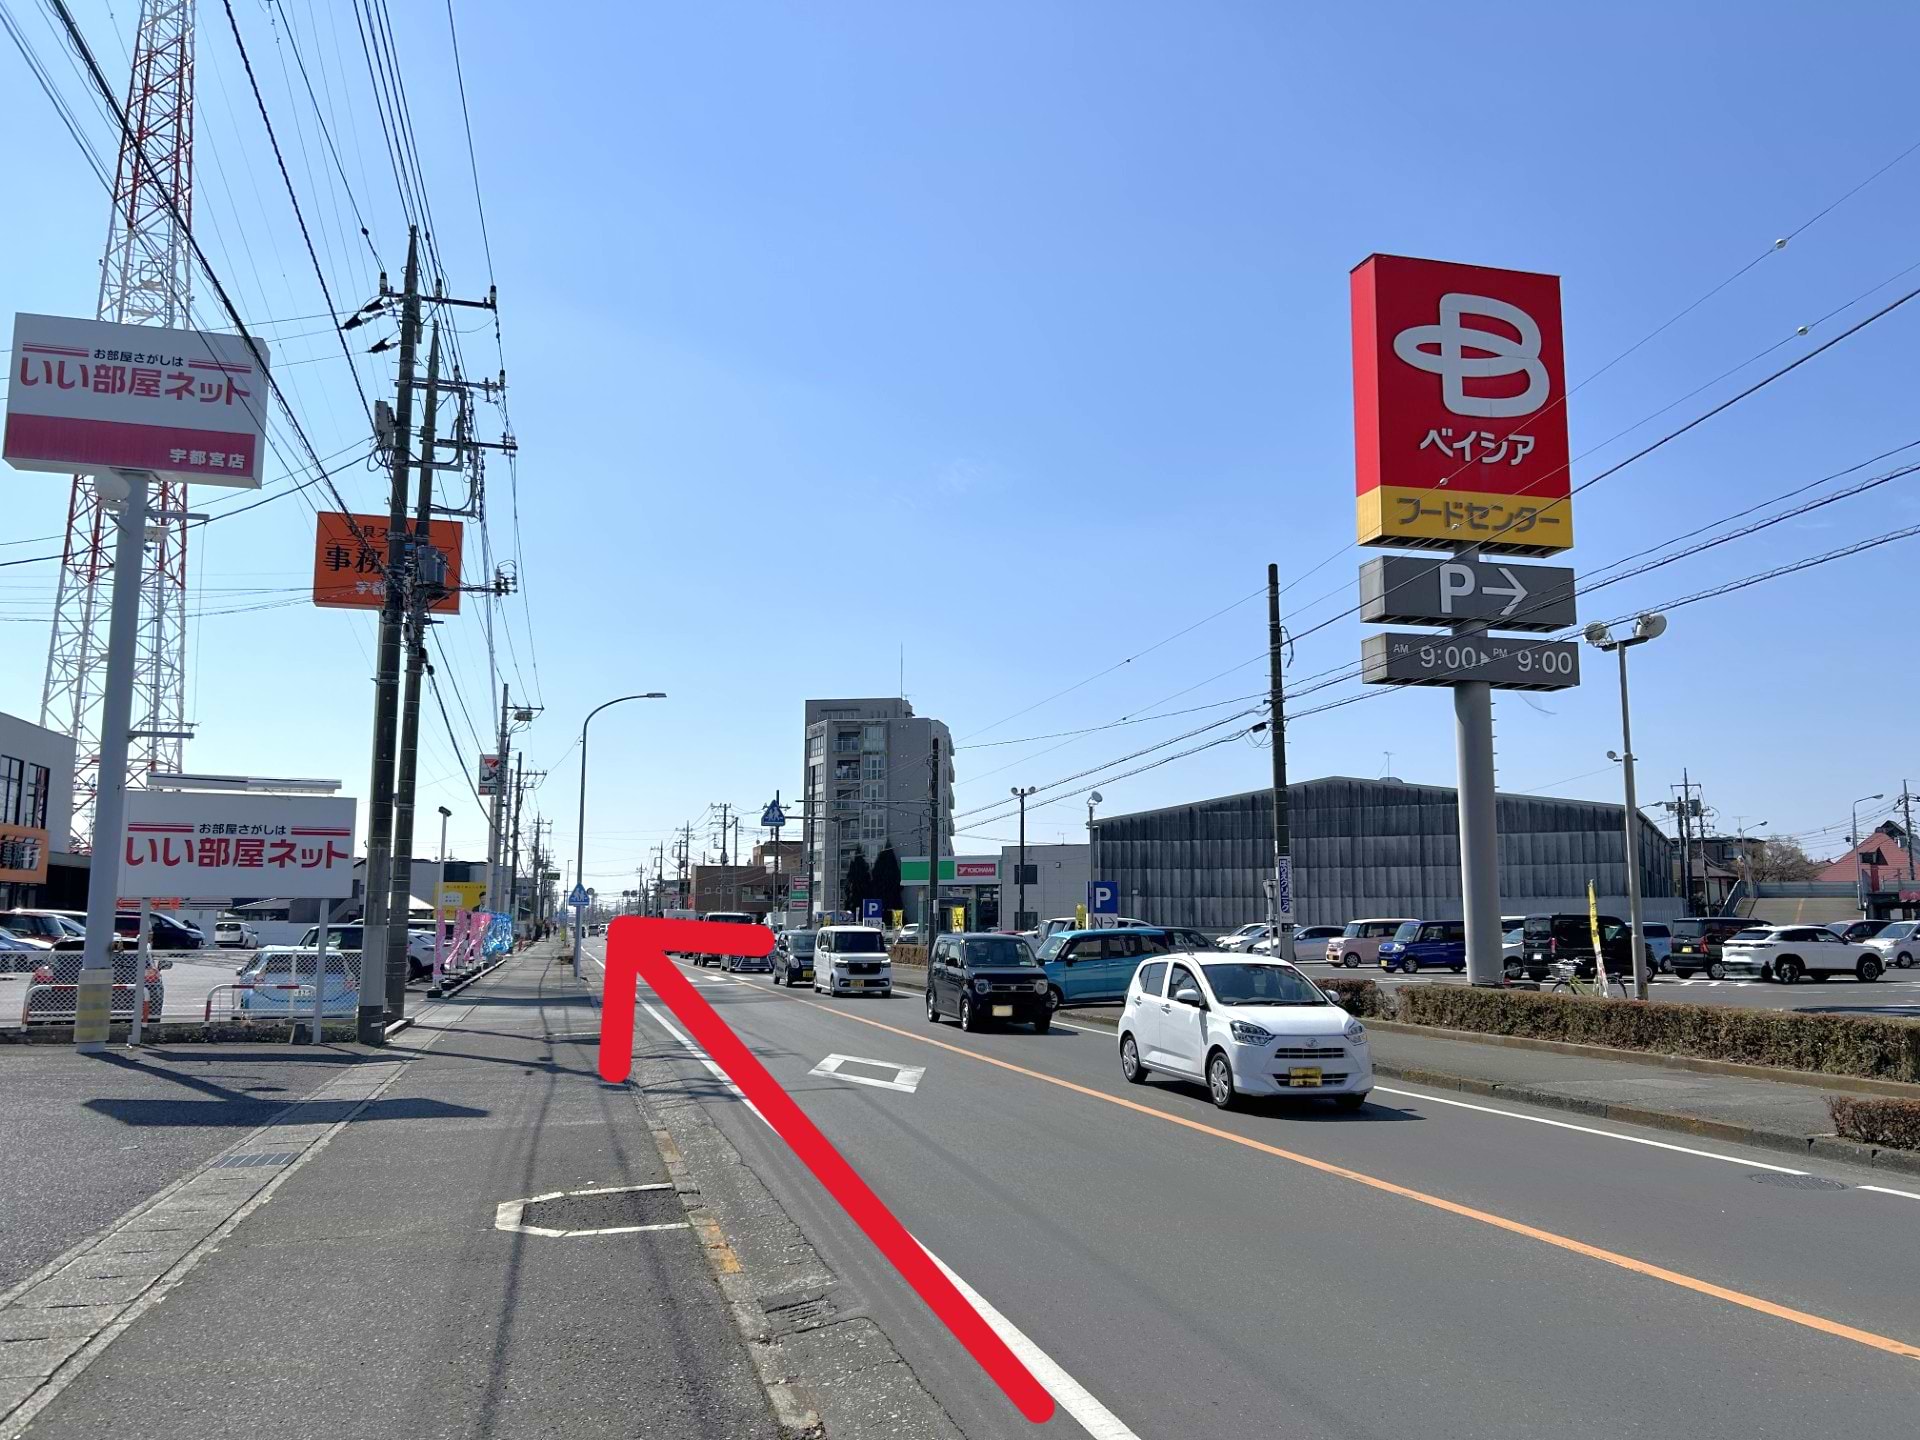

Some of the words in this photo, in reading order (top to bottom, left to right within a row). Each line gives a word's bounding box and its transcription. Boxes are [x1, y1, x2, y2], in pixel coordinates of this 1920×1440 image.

[93, 348, 184, 367] お部屋さがしは
[20, 356, 251, 406] いい部屋ネット
[169, 447, 246, 470] 宇都宮店
[1419, 427, 1536, 467] ベイシア
[1396, 497, 1561, 534] フードセンター
[322, 543, 386, 574] 事務
[1438, 563, 1476, 614] P
[1393, 643, 1409, 654] AM
[1419, 645, 1477, 670] 9:00
[1492, 647, 1508, 658] PM
[1516, 649, 1573, 675] 9:00
[198, 823, 287, 836] お部屋さがしは
[125, 836, 349, 869] いい部屋ネット
[966, 866, 995, 874] YOKOHAMA
[868, 902, 879, 915] P
[1095, 887, 1112, 909] P
